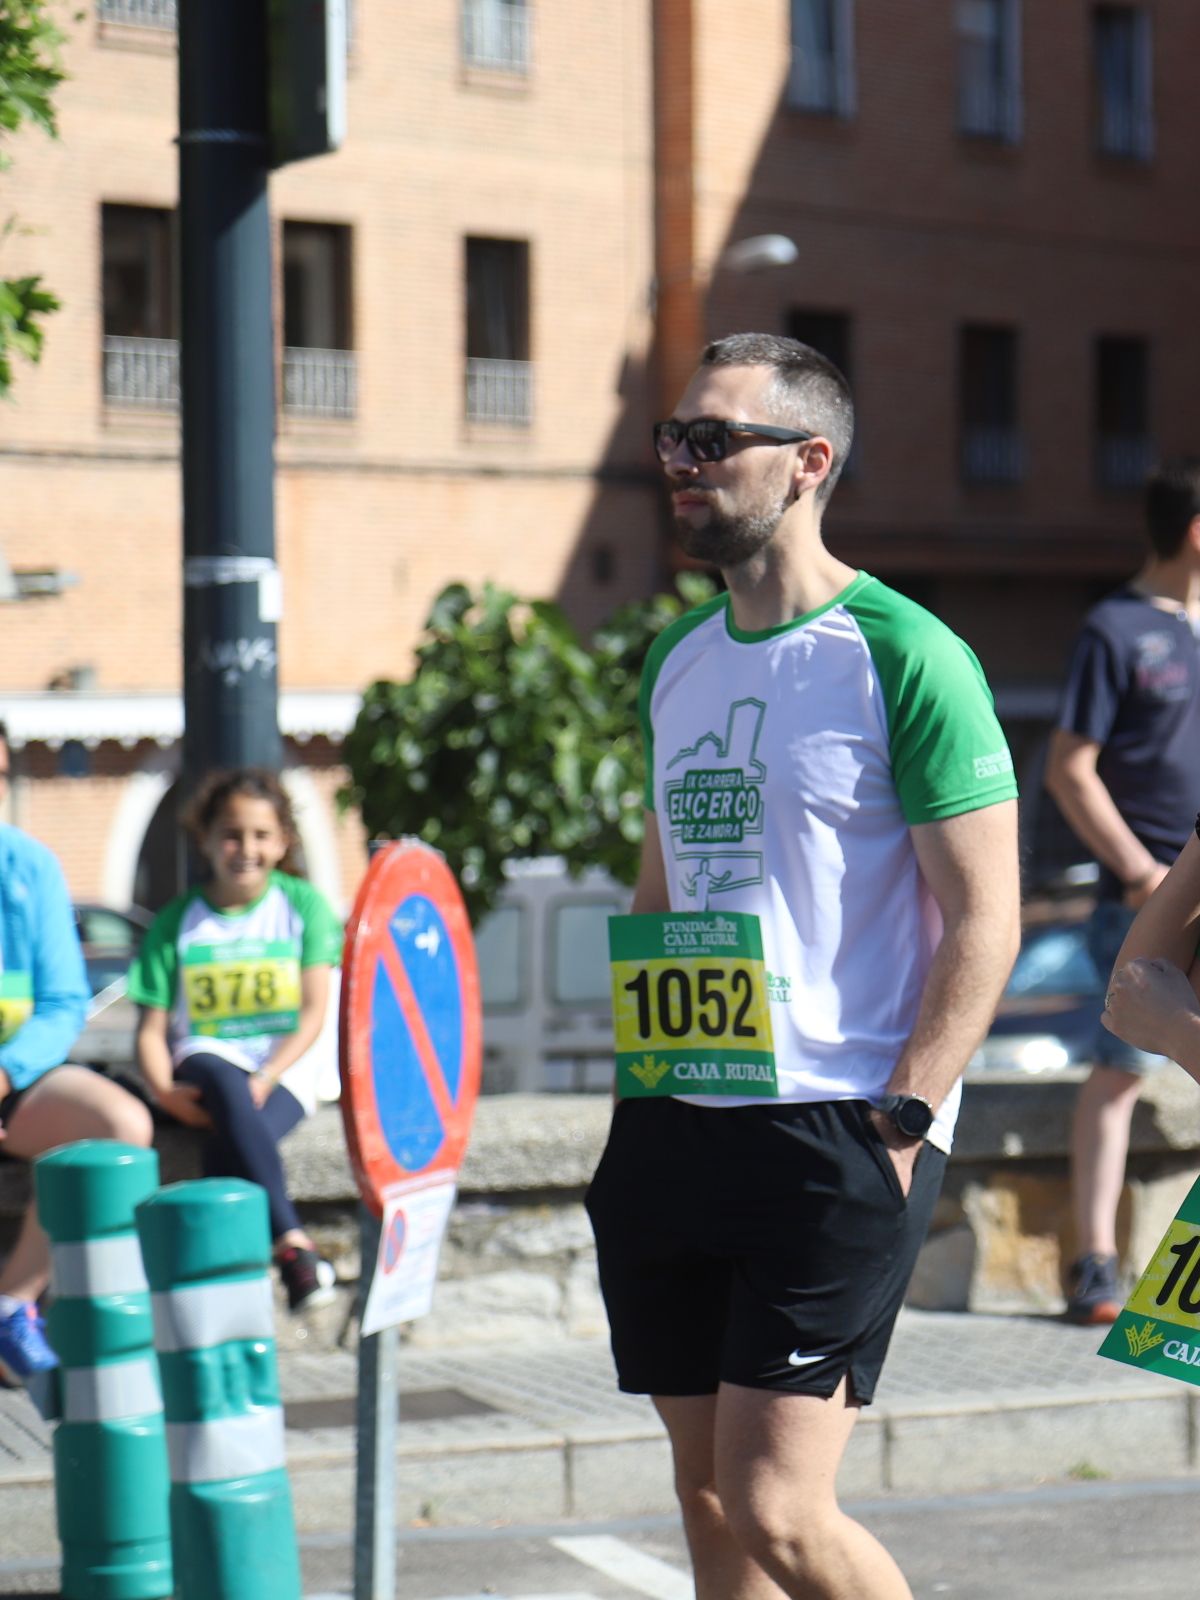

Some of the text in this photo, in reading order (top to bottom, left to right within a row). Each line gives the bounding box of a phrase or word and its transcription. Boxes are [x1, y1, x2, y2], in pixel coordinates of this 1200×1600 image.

[698, 772, 742, 787] CARRERA
[692, 790, 758, 820] CERCO
[663, 933, 739, 946] CAJA RURAL
[194, 970, 278, 1013] 378
[624, 969, 757, 1039] 1052
[673, 1062, 775, 1082] CAJA RURAL
